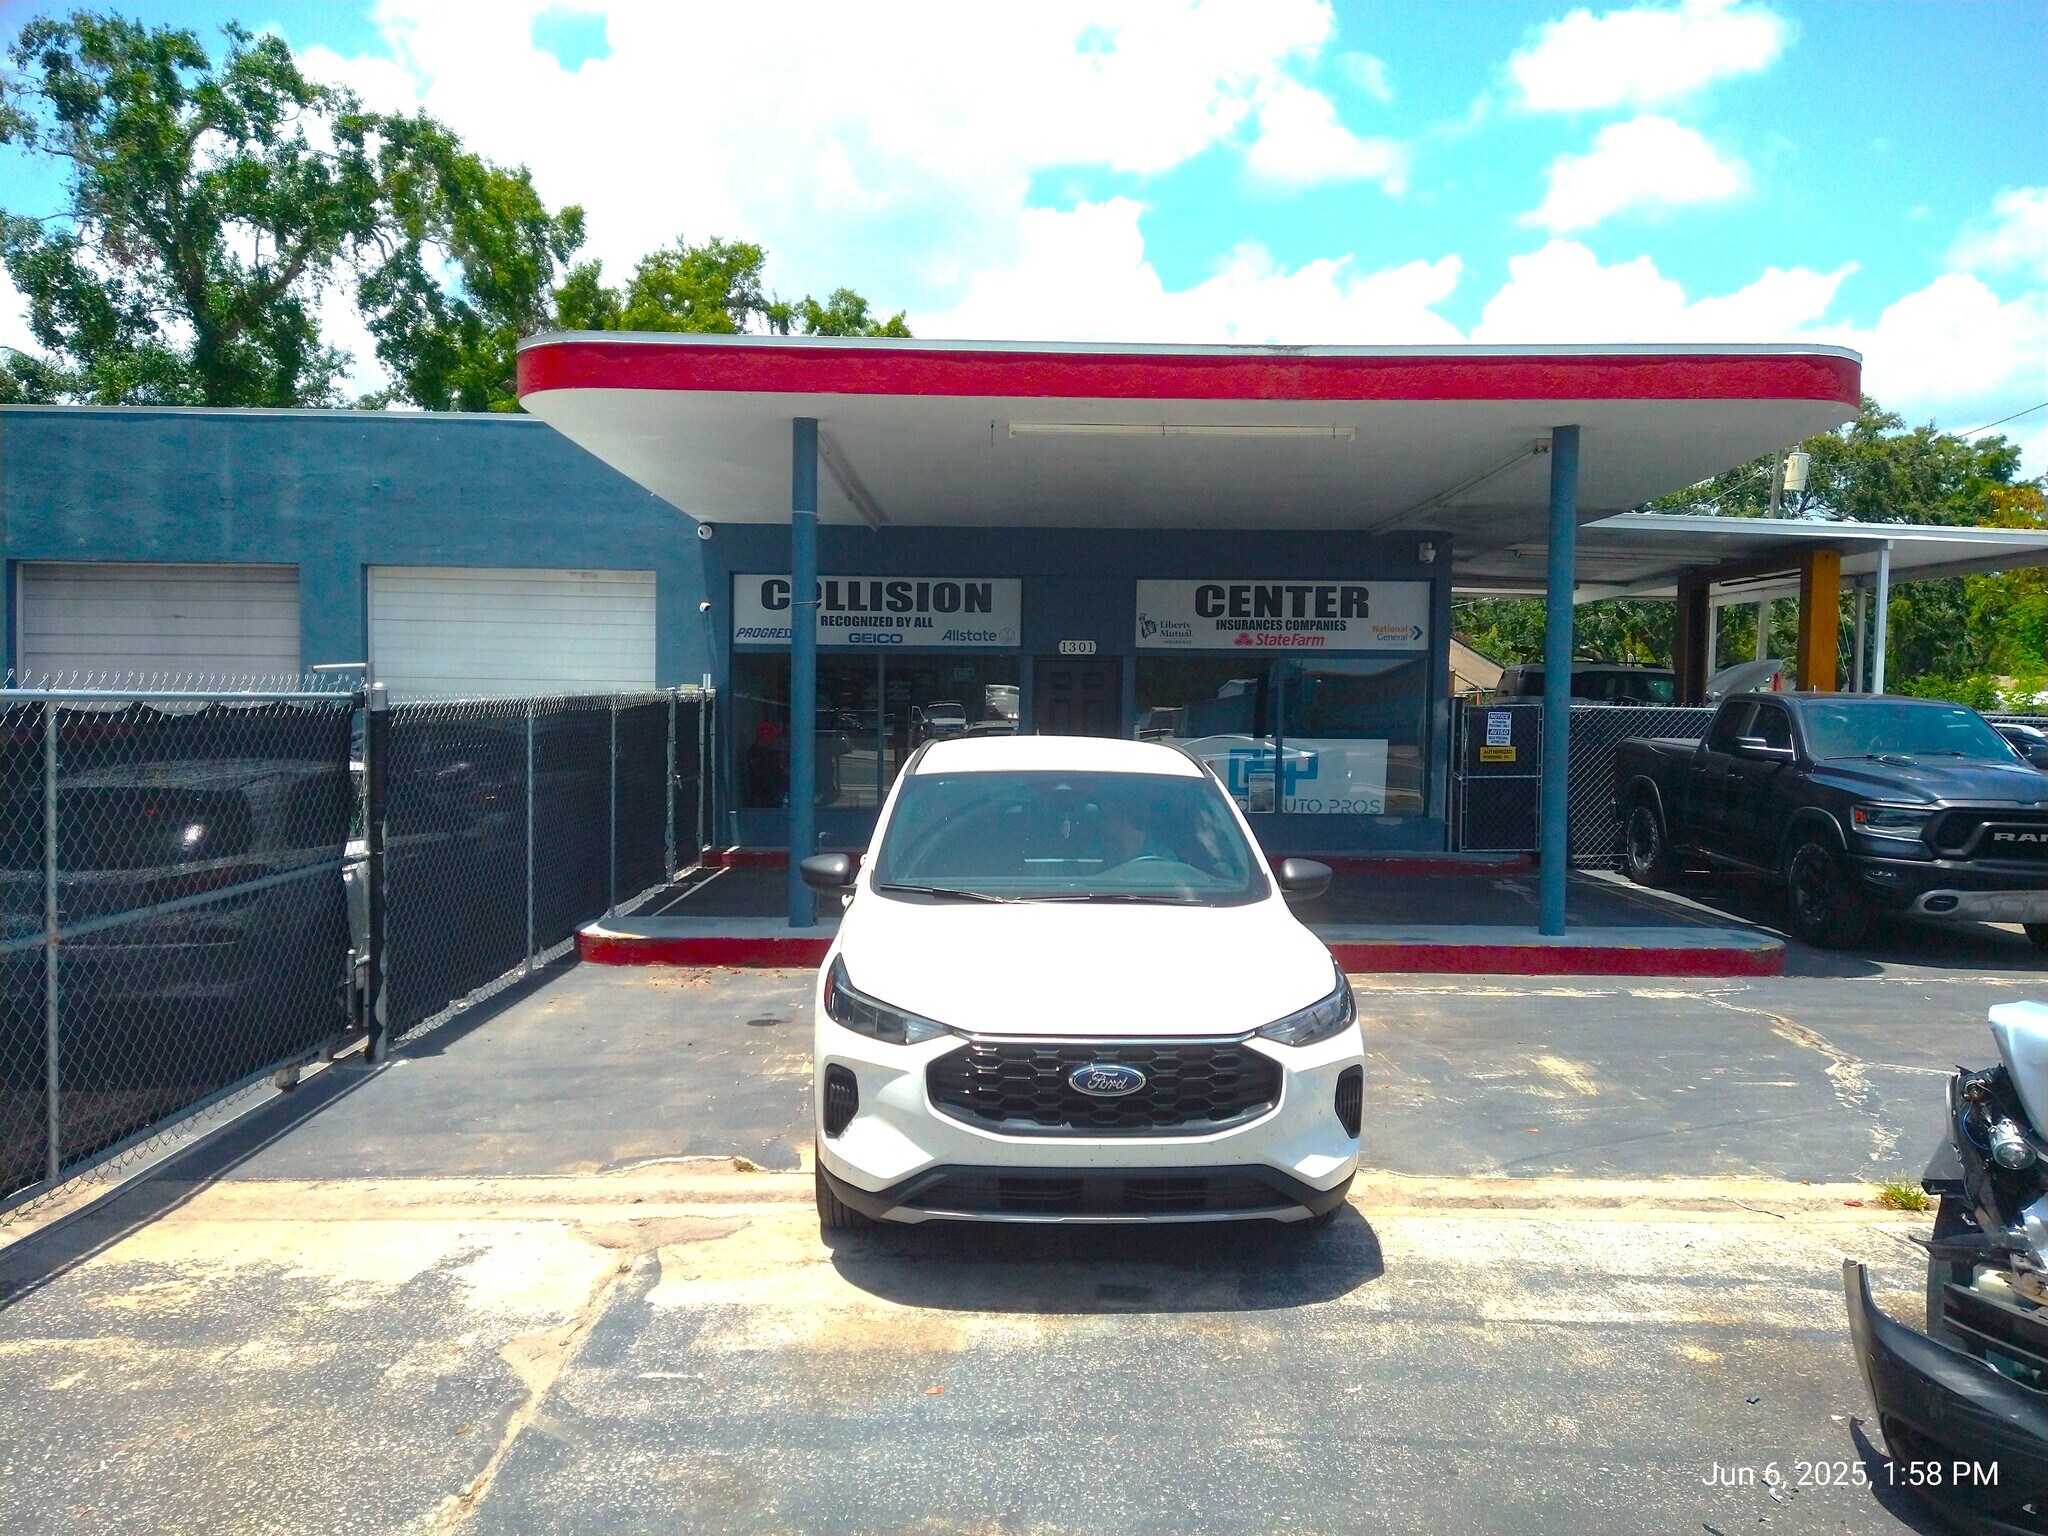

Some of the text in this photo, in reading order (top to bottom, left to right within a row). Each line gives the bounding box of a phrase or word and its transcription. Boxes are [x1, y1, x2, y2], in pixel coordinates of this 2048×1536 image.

[761, 579, 992, 613] CLLISION
[1195, 584, 1370, 618] CENTER
[820, 615, 934, 628] RECOGNIZED BY ALL
[1160, 620, 1192, 630] Liberty
[1216, 619, 1347, 632] INSURANCES COMPANIES
[941, 629, 997, 642] Allstate
[1160, 629, 1192, 638] Mutual
[1372, 625, 1408, 633] National
[848, 632, 903, 644] GEICO
[1376, 632, 1408, 641] General
[1061, 641, 1094, 653] 1301
[1283, 798, 1322, 814] UTO
[1329, 799, 1380, 814] PROS
[1087, 1070, 1129, 1090] Ford
